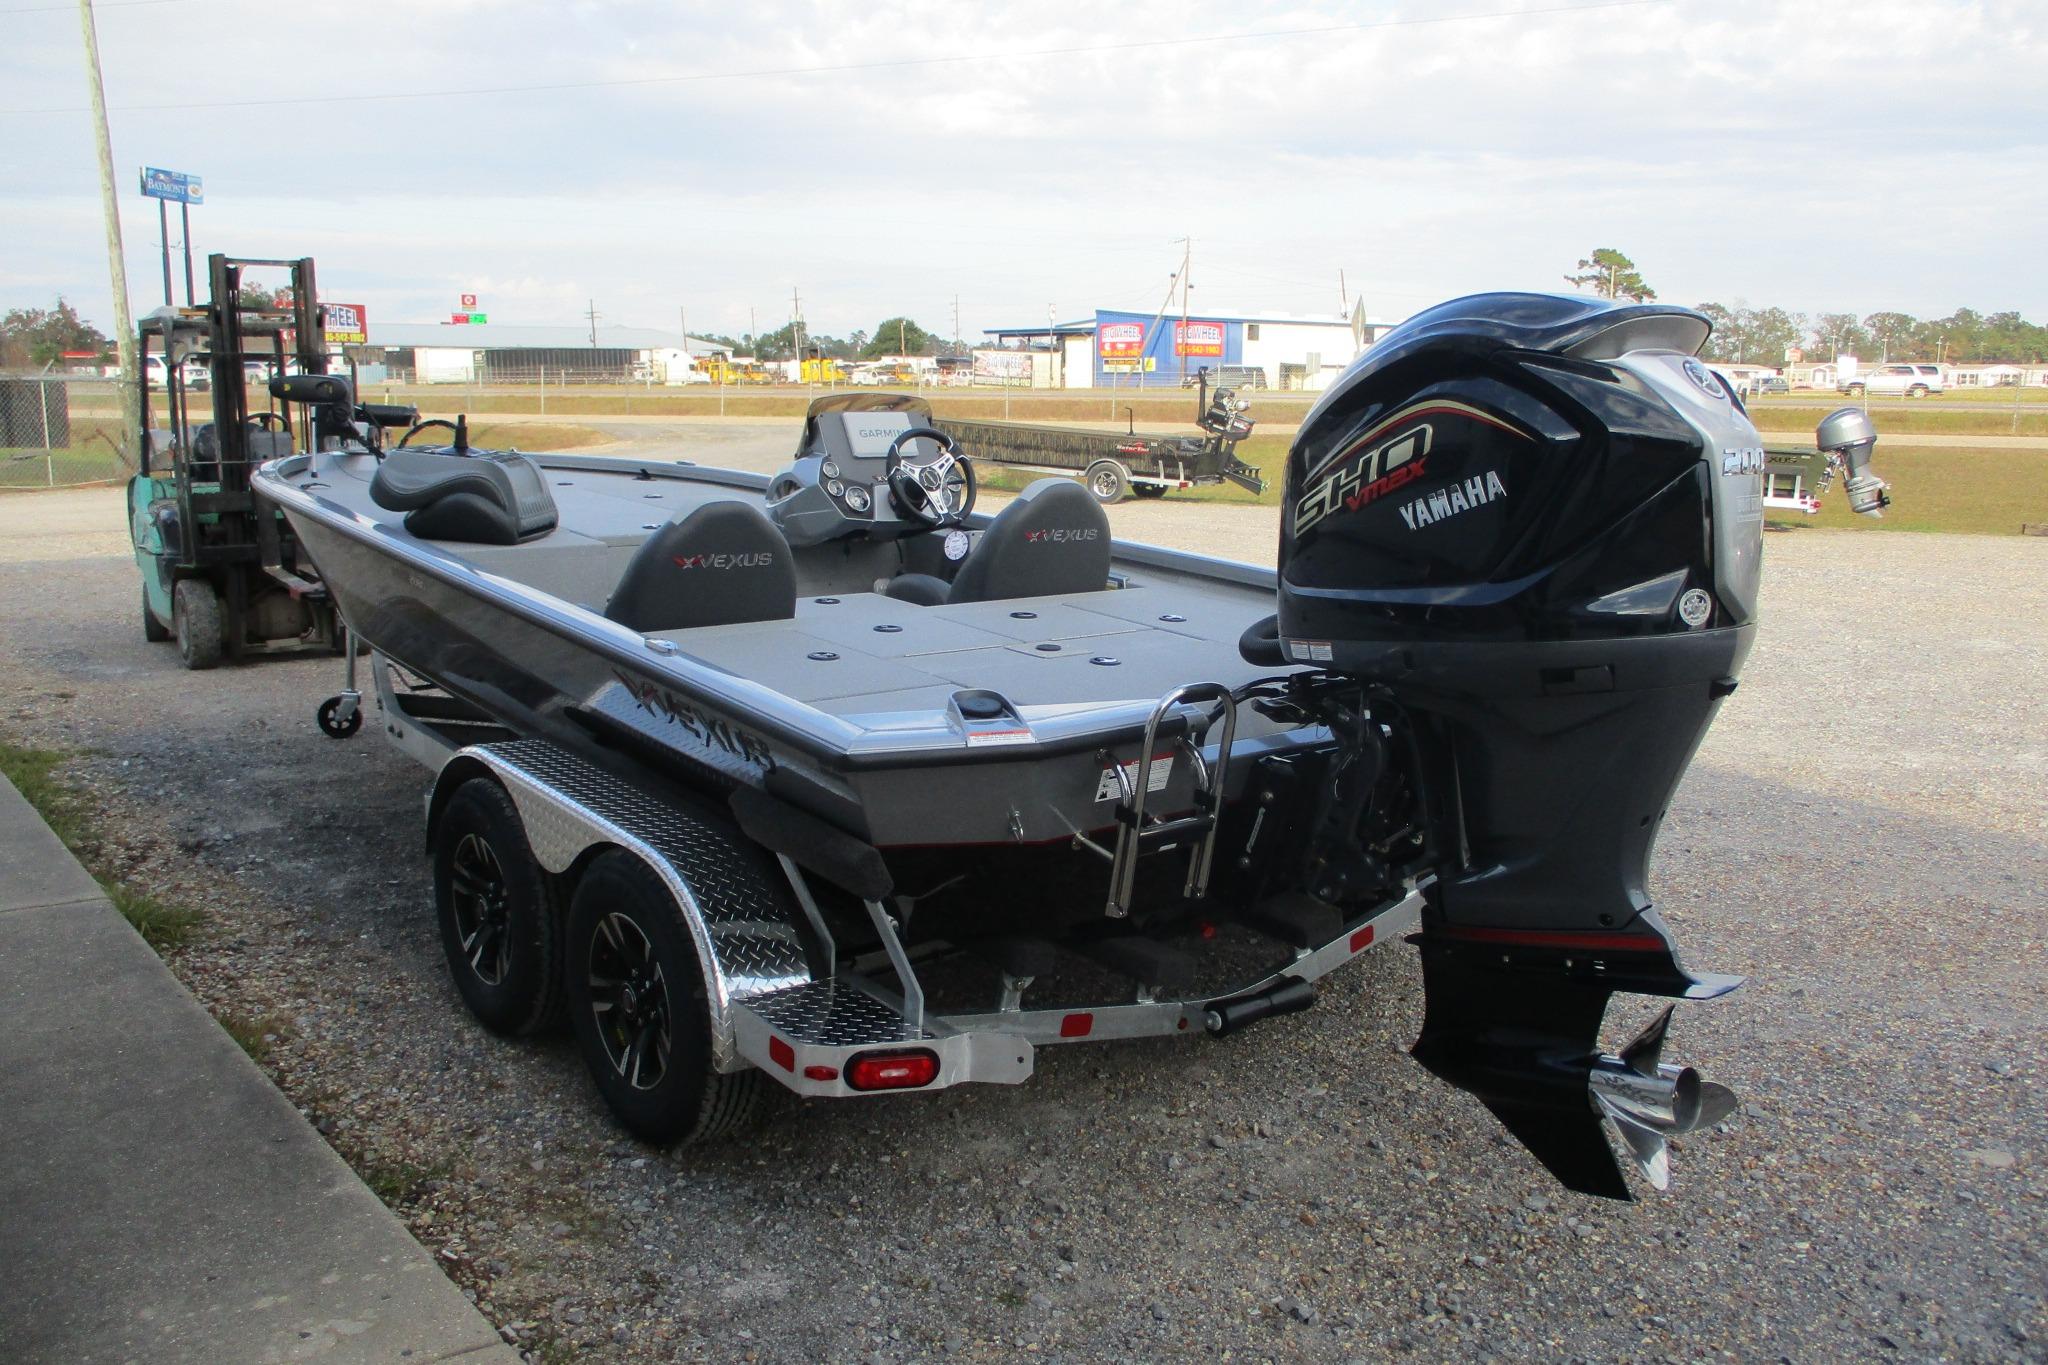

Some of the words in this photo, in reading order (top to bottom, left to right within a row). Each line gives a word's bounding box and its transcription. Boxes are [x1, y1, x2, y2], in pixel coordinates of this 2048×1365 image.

[147, 177, 187, 195] BAYMONT
[324, 304, 361, 327] HEEL
[1116, 325, 1142, 339] WHEEL
[1178, 327, 1193, 339] BG
[1294, 423, 1434, 539] SHO
[1399, 470, 1507, 530] YAMAHA
[1043, 528, 1098, 543] VEXUS
[700, 552, 772, 570] VEXUS
